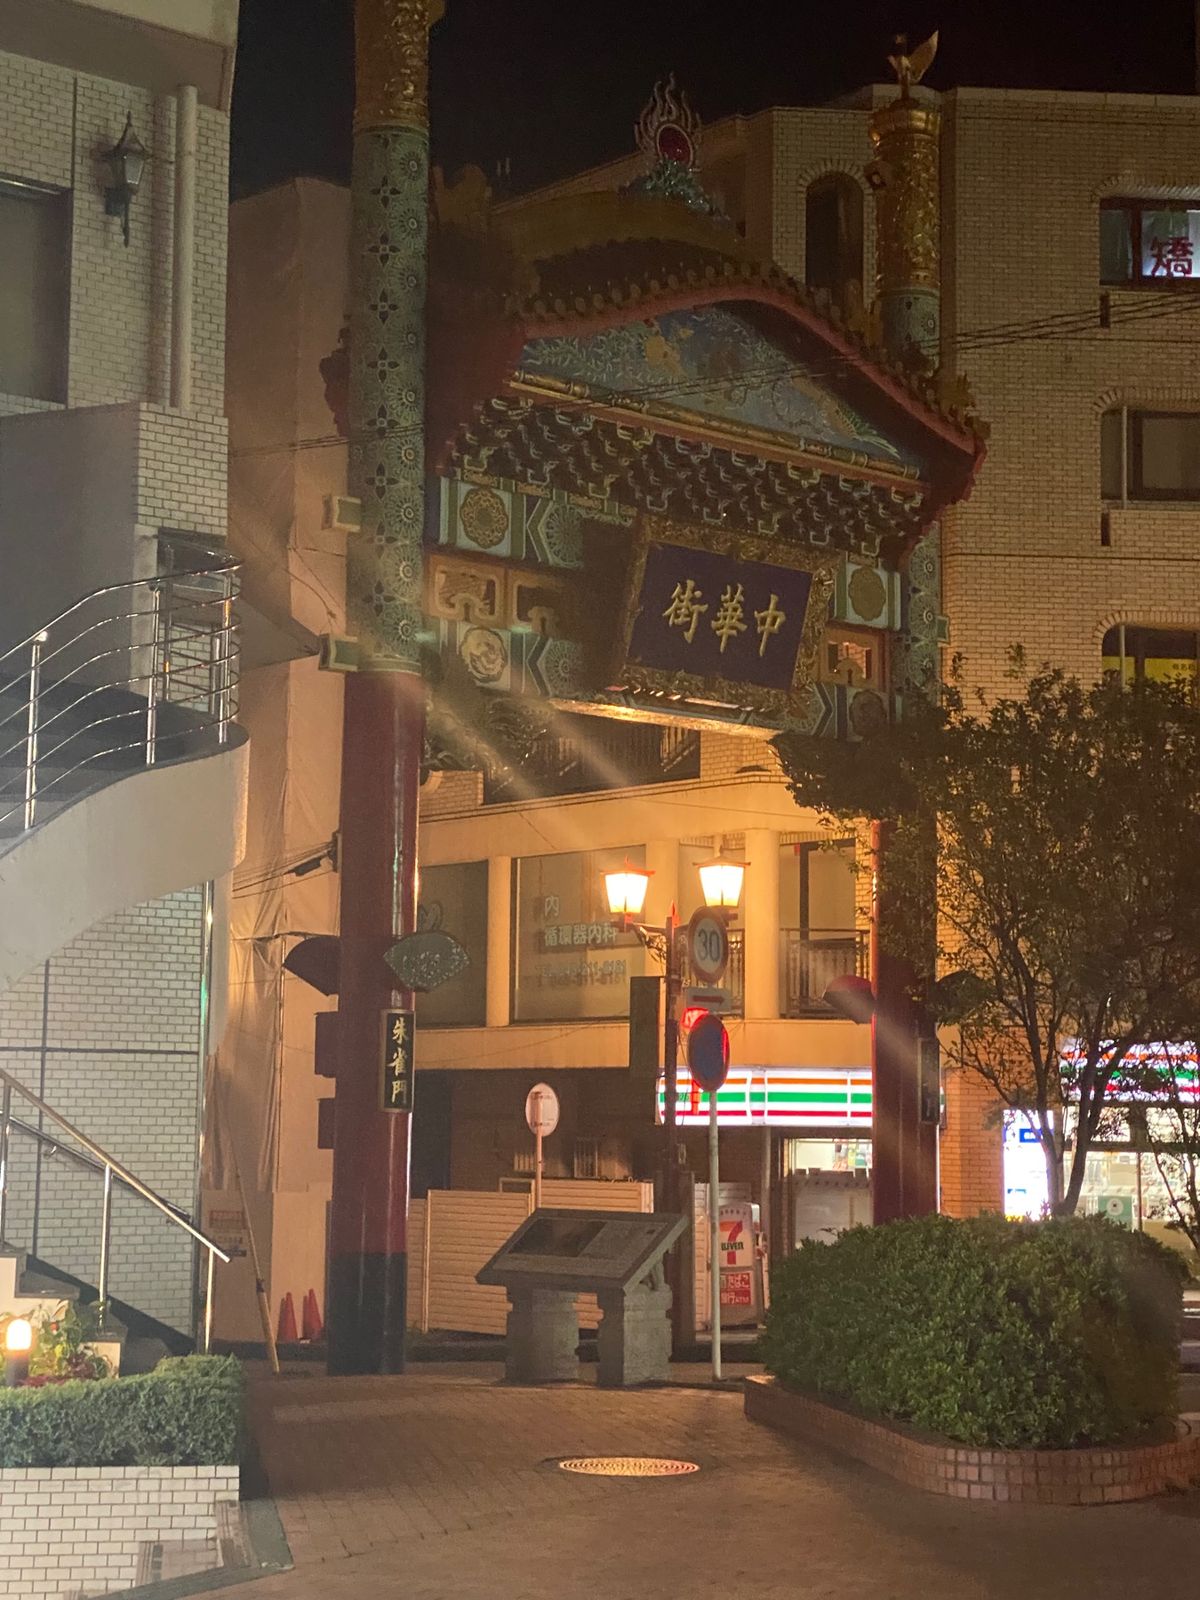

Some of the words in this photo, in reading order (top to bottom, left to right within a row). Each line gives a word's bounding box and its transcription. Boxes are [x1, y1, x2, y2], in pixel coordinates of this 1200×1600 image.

[662, 579, 787, 657] 中華街
[544, 923, 617, 946] 循環器内科
[698, 928, 719, 961] 30
[387, 1017, 410, 1105] 朱雀門
[720, 1220, 742, 1265] 7
